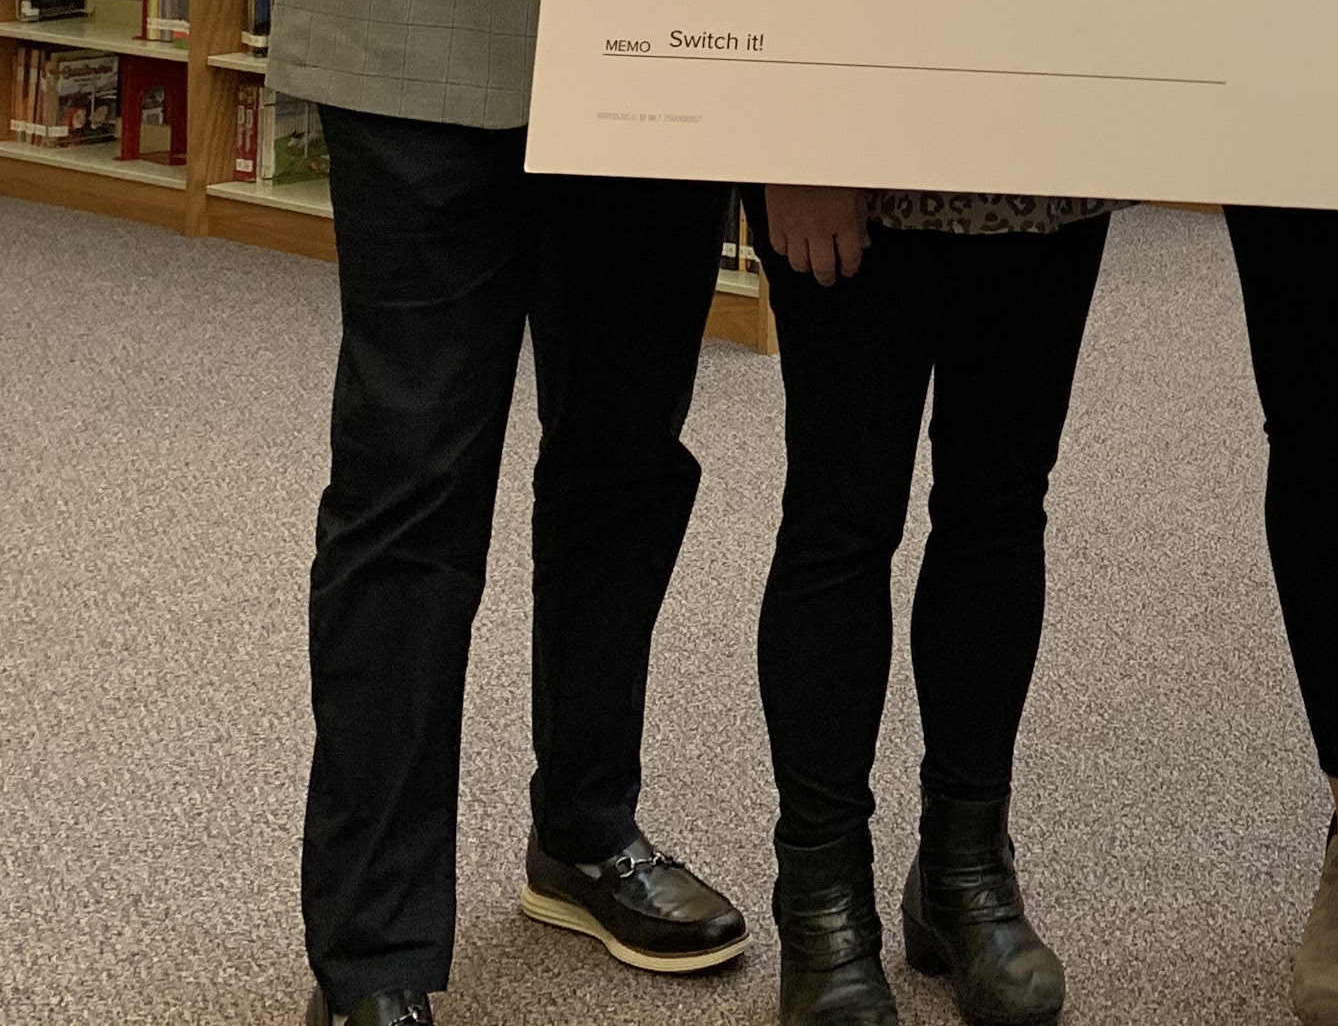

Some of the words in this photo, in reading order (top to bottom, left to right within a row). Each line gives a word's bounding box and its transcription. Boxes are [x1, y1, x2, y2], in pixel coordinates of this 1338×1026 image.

[605, 39, 651, 53] MEMO
[669, 30, 738, 50] Switch
[746, 33, 764, 52] it!
